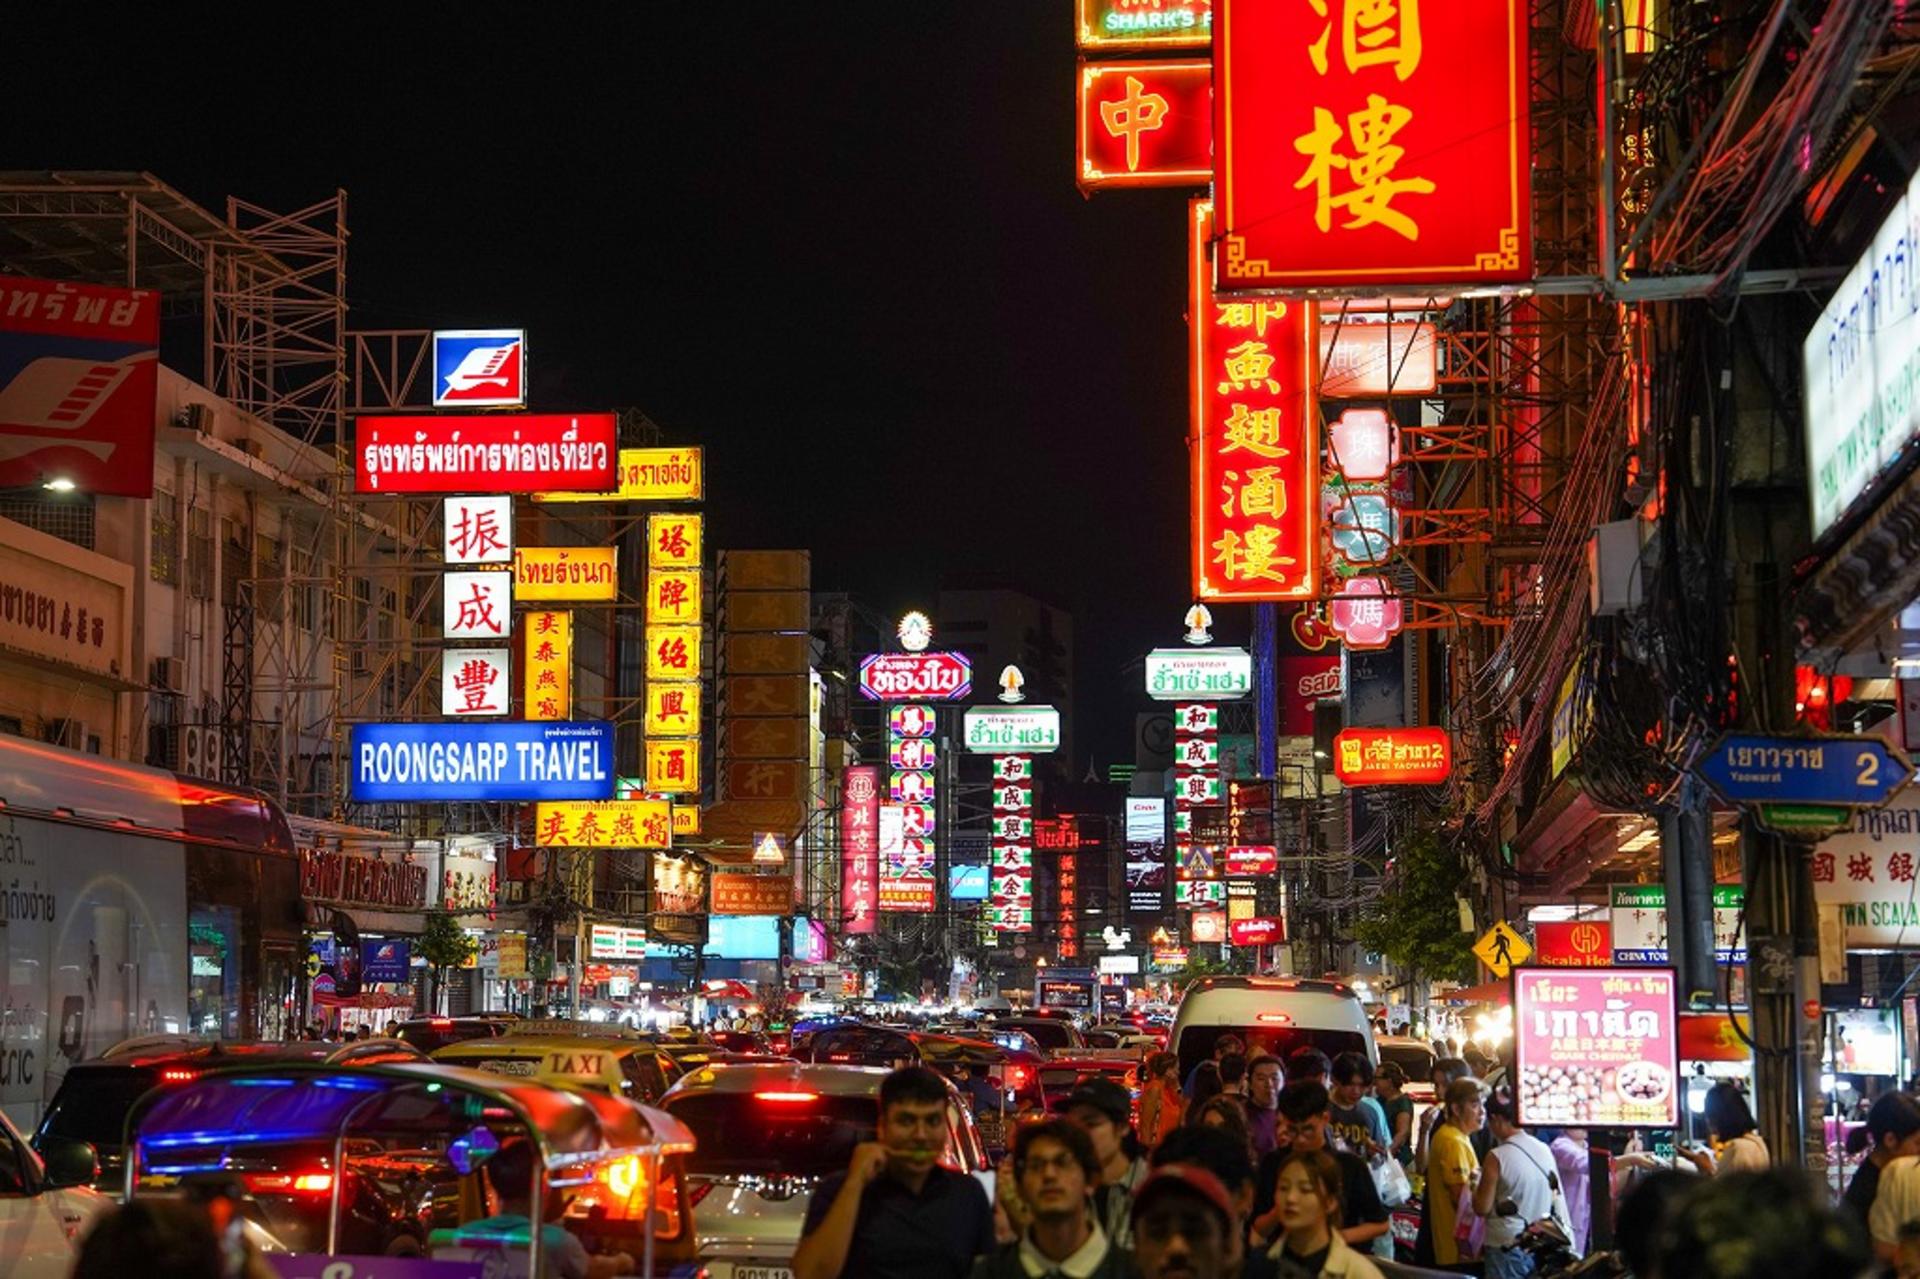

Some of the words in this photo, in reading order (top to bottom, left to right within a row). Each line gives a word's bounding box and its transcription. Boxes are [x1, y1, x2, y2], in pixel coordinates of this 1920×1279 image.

[1106, 12, 1195, 30] SHARK'S
[1100, 76, 1171, 172] 中
[0, 280, 149, 327] ทรัพย์
[365, 418, 607, 488] รุ่งทรัพย์การท่องเที่ยว
[0, 583, 55, 634] ขายยา
[449, 507, 509, 714] 振成豐
[872, 660, 960, 693] ทองใบ
[360, 742, 508, 783] ROONGSARP
[516, 740, 606, 781] TRAVEL
[1431, 744, 1444, 759] 2
[1728, 746, 1824, 769] เยาวราช
[1856, 752, 1880, 786] 2
[1731, 771, 1782, 783] Yaowarat
[1186, 709, 1209, 901] 和成興行
[851, 807, 872, 920] 北京同仁堂
[1844, 903, 1868, 926] WN
[1541, 955, 1582, 966] Scala
[1533, 999, 1661, 1039] เกาลัด
[550, 1053, 604, 1075] TAXI
